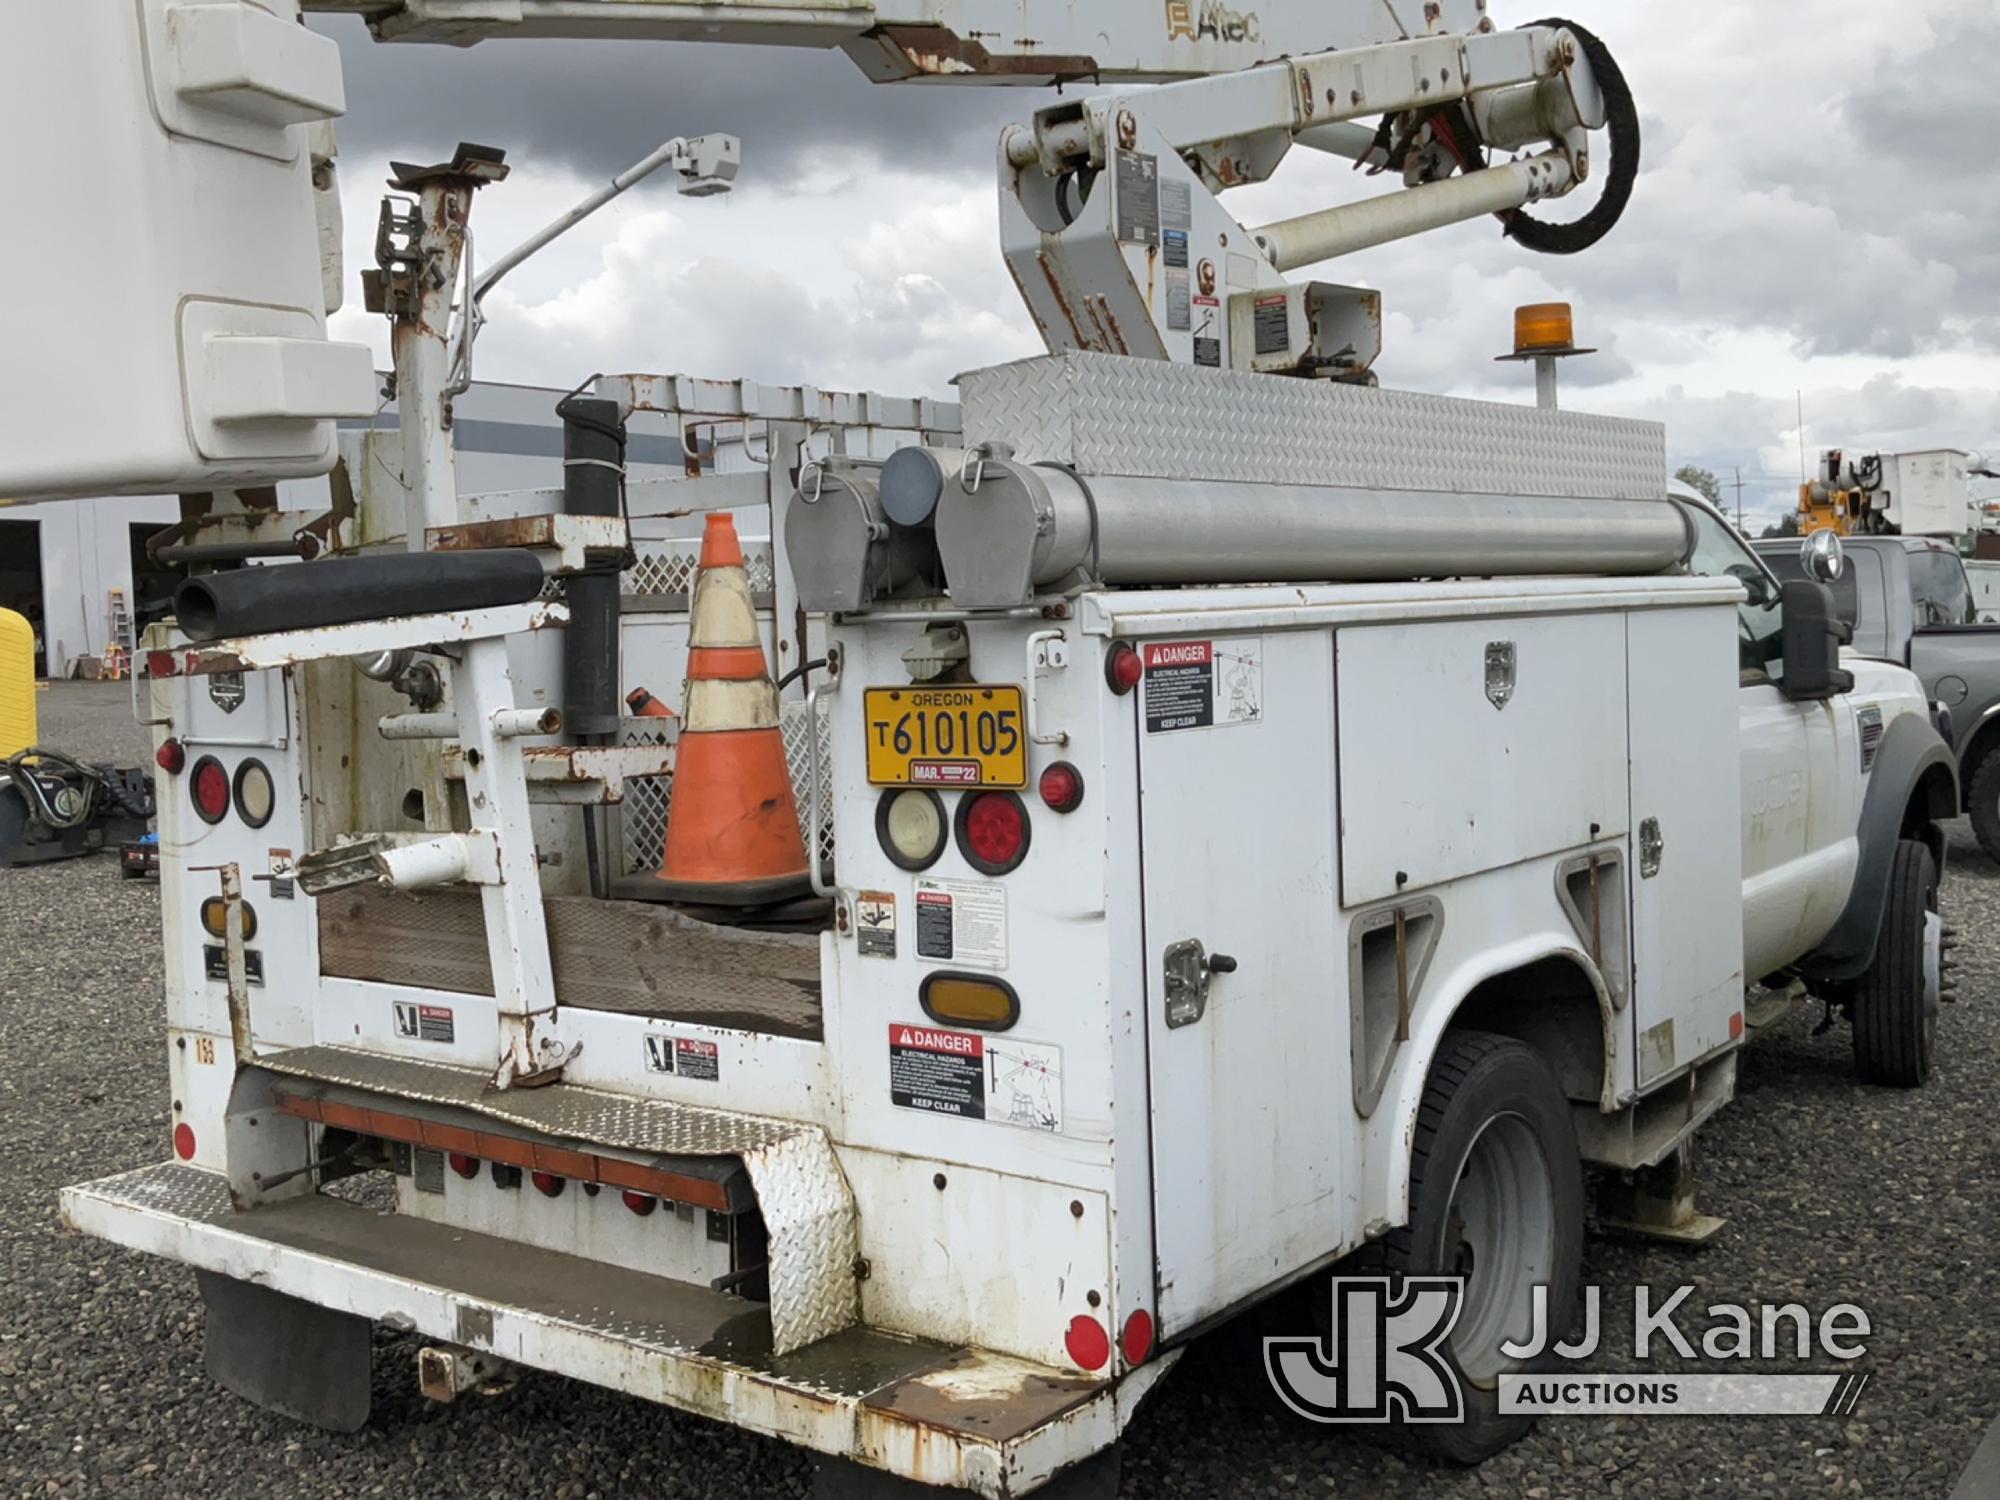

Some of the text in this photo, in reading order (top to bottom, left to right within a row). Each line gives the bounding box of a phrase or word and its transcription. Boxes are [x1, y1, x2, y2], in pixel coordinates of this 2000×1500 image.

[1163, 646, 1205, 663] DANGER
[912, 693, 973, 707] OREGON
[1160, 716, 1197, 729] KEEP CLEAR
[914, 766, 976, 781] MAR. 22
[914, 1031, 973, 1053] DANGER
[901, 1049, 966, 1065] ELECTRICAL HAZARDS
[912, 1097, 961, 1113] KEEP CLEAR
